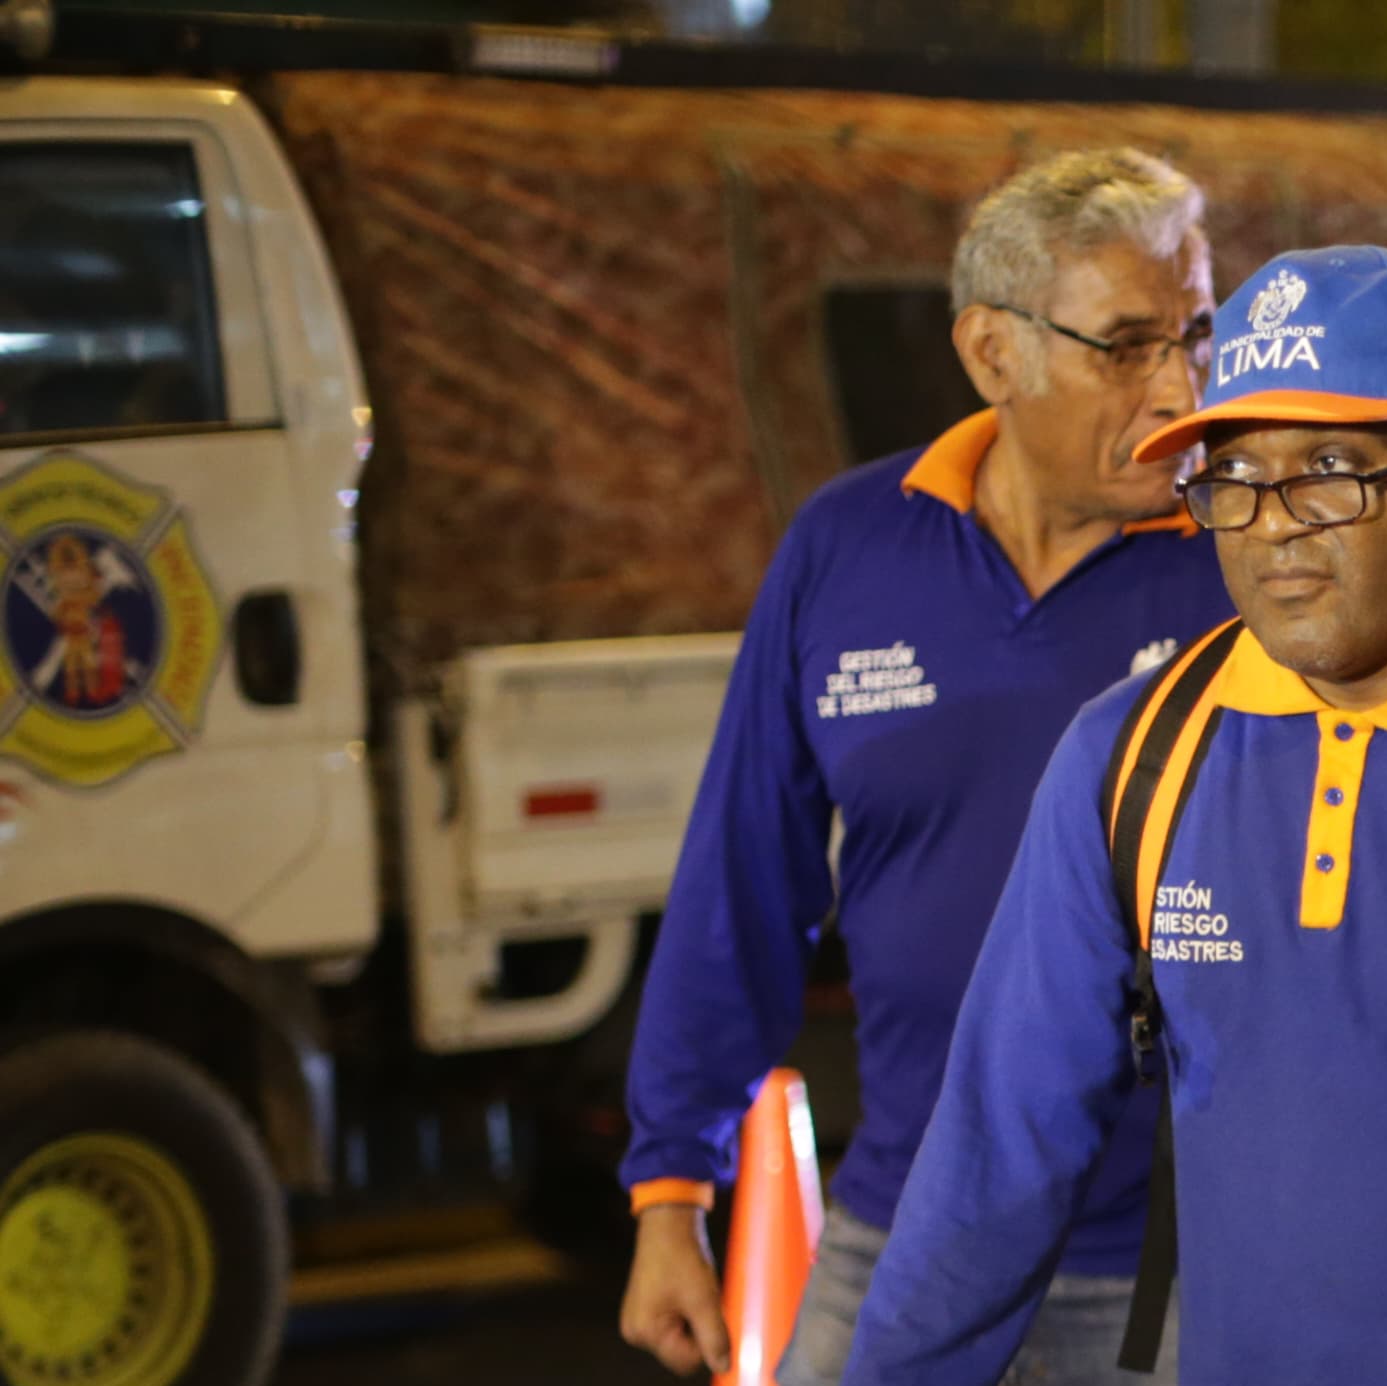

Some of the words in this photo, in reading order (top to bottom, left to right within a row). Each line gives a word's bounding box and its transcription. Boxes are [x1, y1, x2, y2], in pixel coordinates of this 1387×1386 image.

[1219, 325, 1304, 355] MUNICIPALIDAD
[1305, 325, 1326, 338] DE
[1217, 336, 1321, 388] LIMA
[838, 640, 916, 673] GESTIÓN
[1154, 912, 1229, 936] RIESGO
